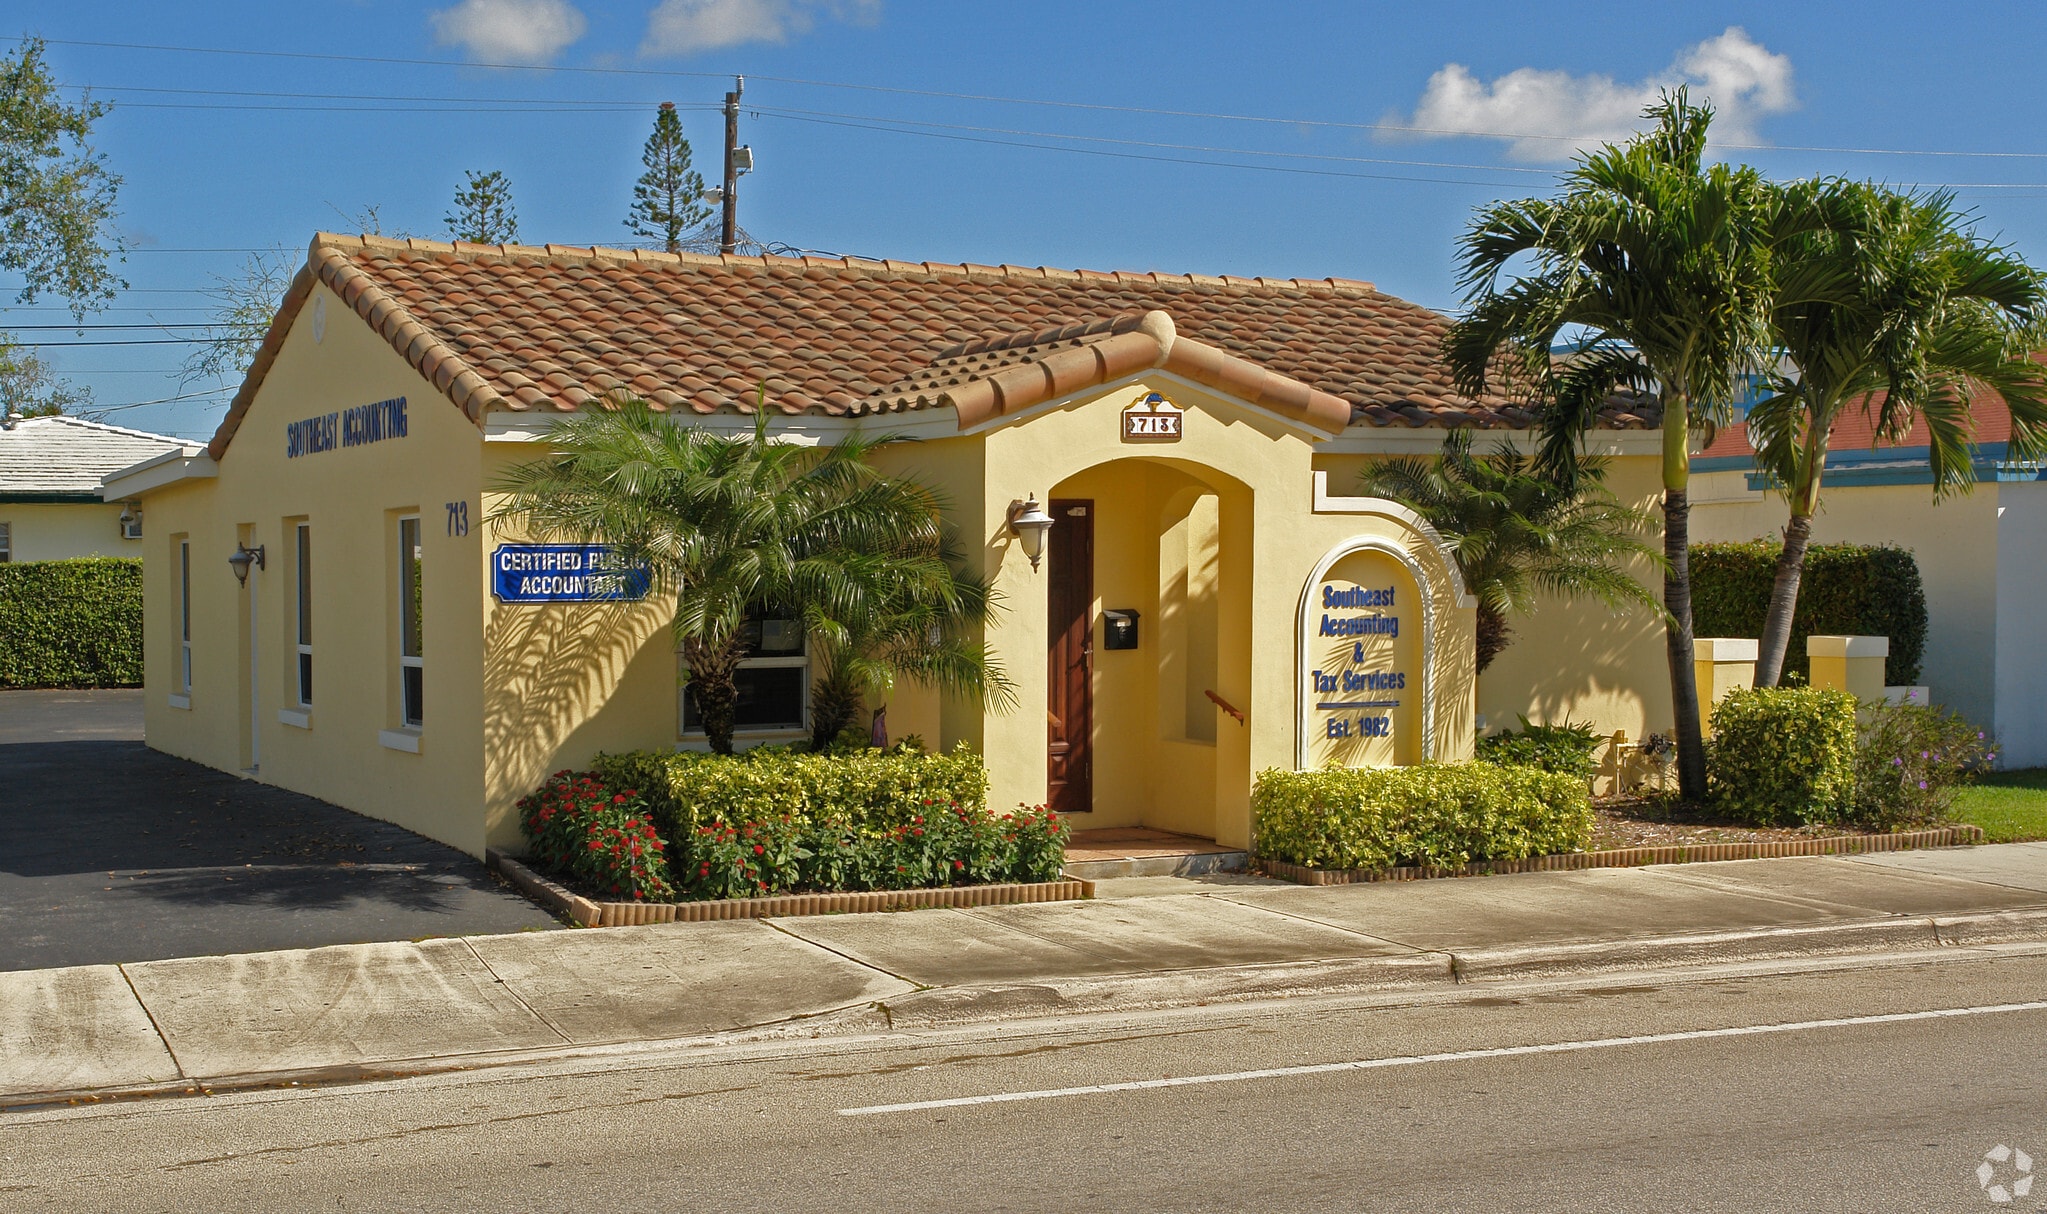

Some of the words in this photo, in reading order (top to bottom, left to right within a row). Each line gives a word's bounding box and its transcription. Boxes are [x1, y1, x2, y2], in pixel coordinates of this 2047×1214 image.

[287, 412, 339, 459] SOUTHEAST
[342, 396, 408, 448] ACCOUNTING
[1138, 418, 1169, 432] 713
[446, 501, 468, 537] 713
[501, 552, 581, 571] CERTIFIED
[1322, 585, 1395, 609] Southeast
[1319, 614, 1399, 638] Accounting
[1353, 642, 1364, 663] &
[1312, 670, 1338, 693] Tax
[1343, 669, 1406, 692] Services
[1326, 718, 1353, 740] Est.
[1358, 716, 1390, 738] 1982
